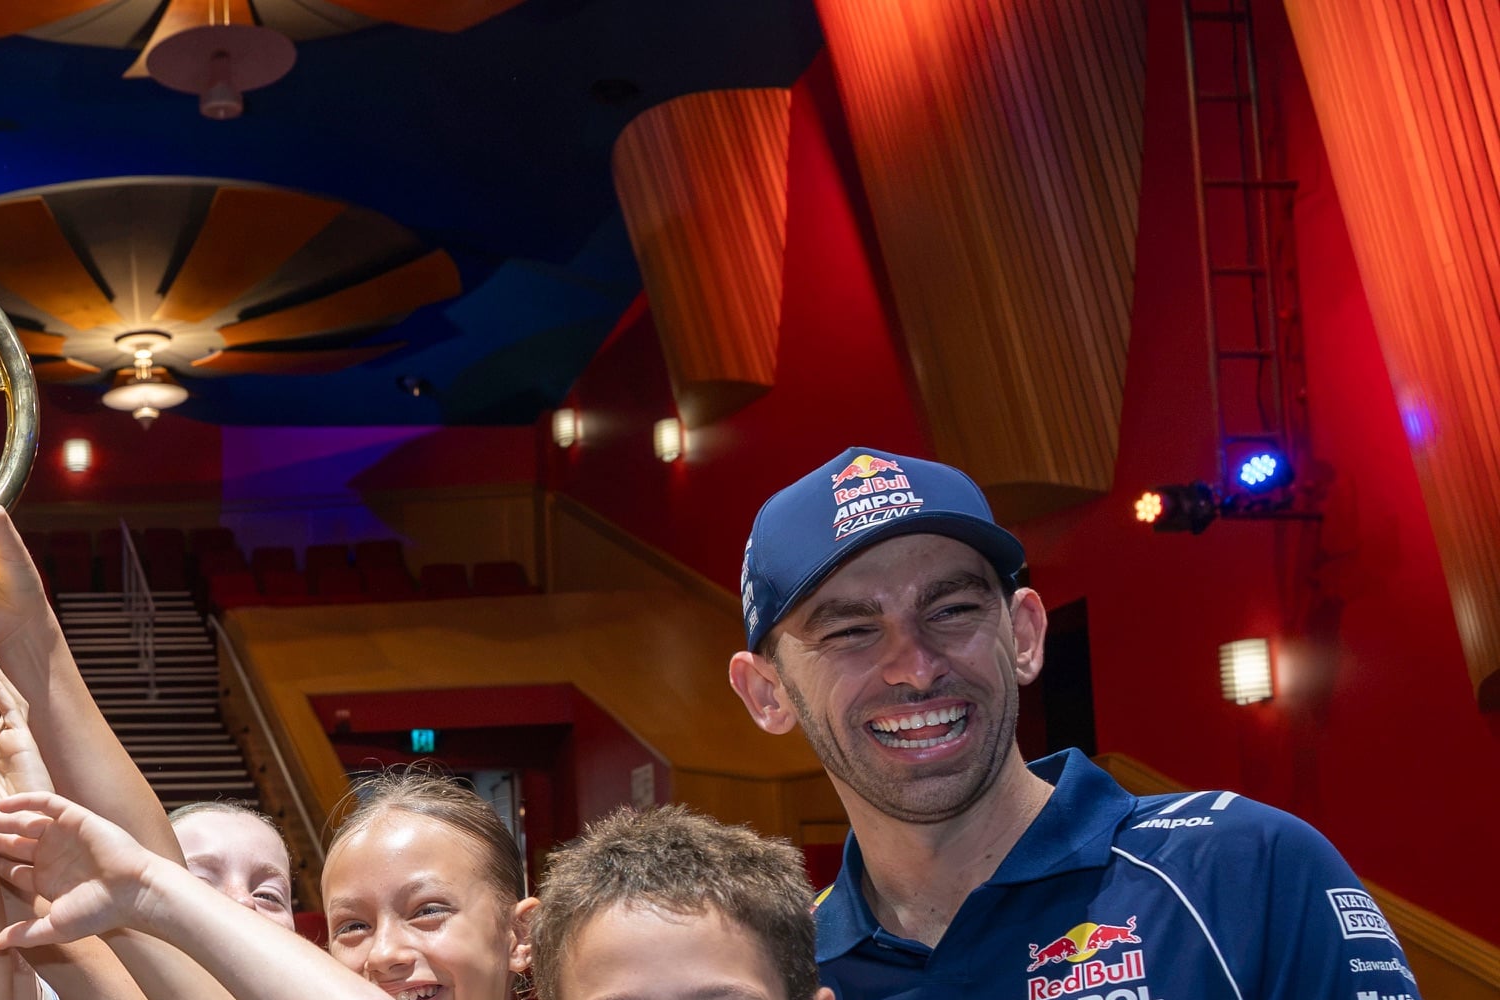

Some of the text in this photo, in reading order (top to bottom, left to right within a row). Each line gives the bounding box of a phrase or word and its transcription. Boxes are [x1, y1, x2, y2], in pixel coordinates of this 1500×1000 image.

[834, 475, 911, 505] Red Bull
[834, 491, 924, 524] AMPOL
[836, 505, 922, 537] RACING
[1131, 816, 1214, 829] AMPOL
[1085, 950, 1146, 989] Bull
